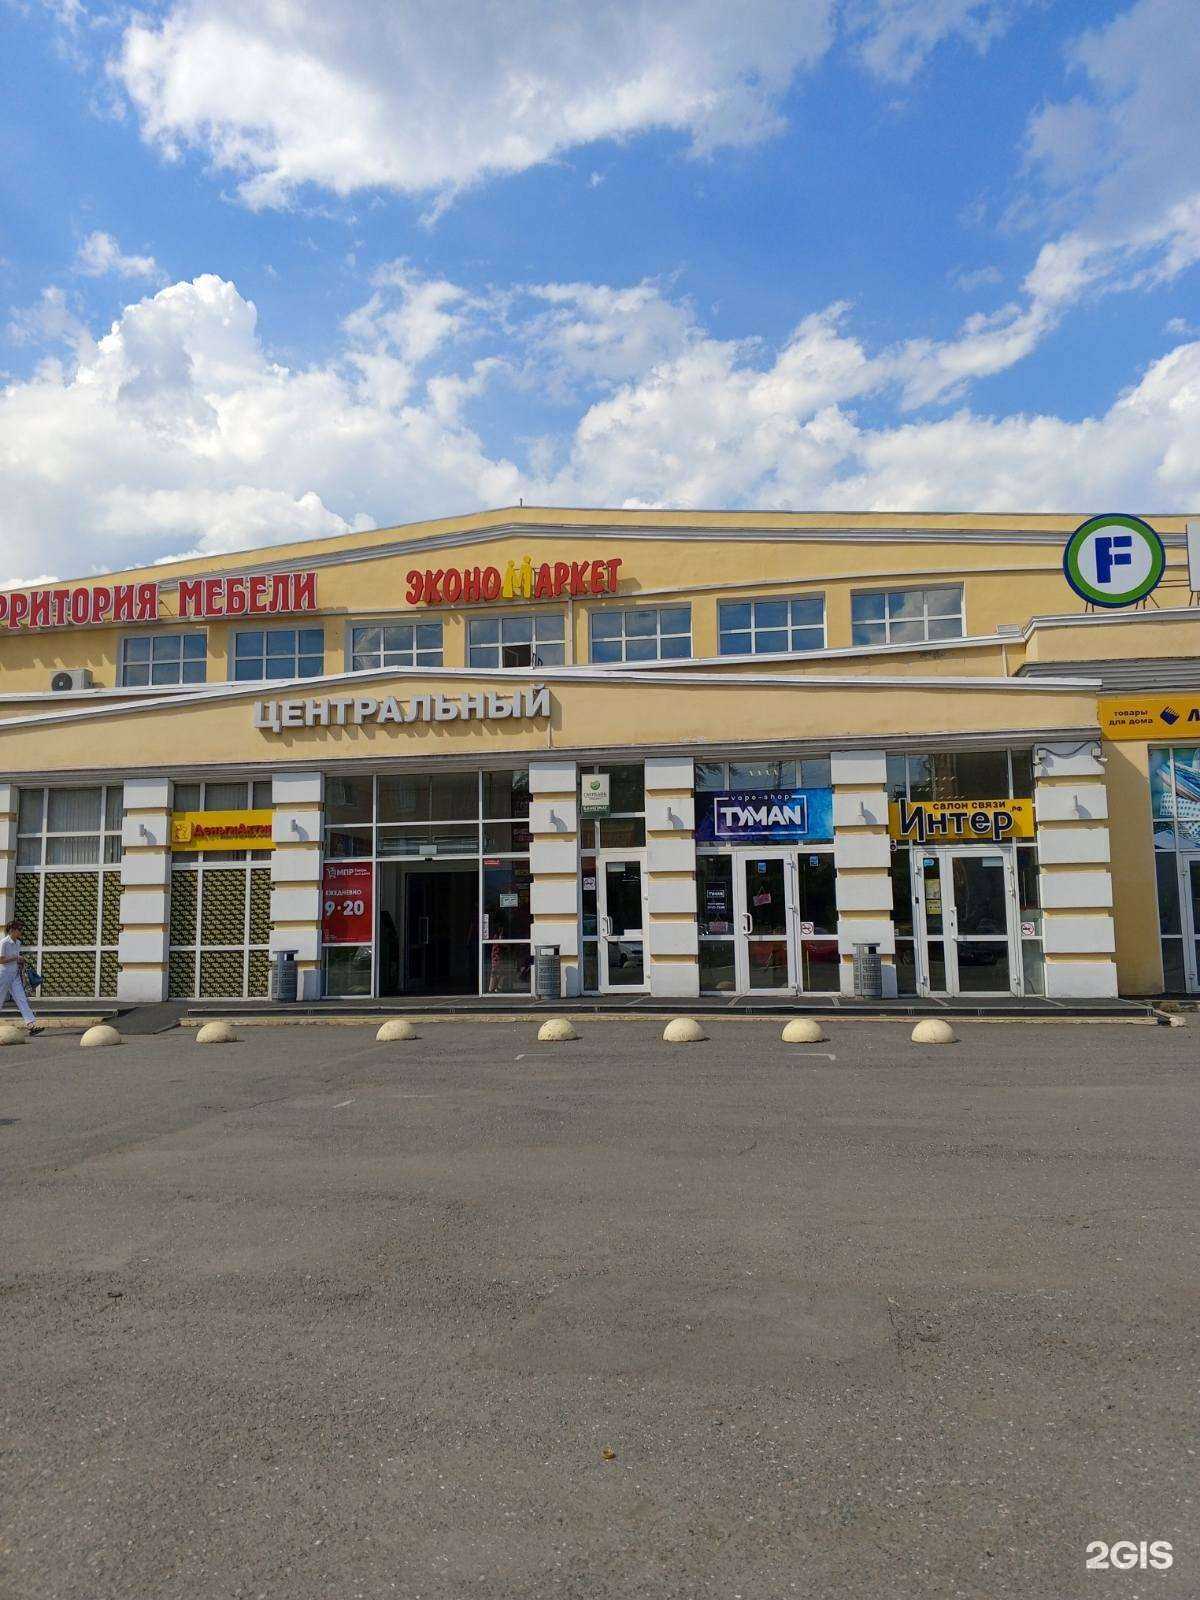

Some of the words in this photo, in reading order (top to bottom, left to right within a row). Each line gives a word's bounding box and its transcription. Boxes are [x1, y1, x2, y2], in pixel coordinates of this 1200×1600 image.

[405, 554, 623, 605] ЭКОНОМАРКЕТ
[1095, 536, 1132, 583] F
[177, 571, 318, 618] МЕБЕЛИ
[254, 683, 551, 734] ЦЕНТРАЛЬНЫЙ
[731, 794, 790, 802] vape-shop
[899, 798, 1014, 843] Интер
[933, 801, 968, 810] салон
[971, 801, 1006, 809] связи
